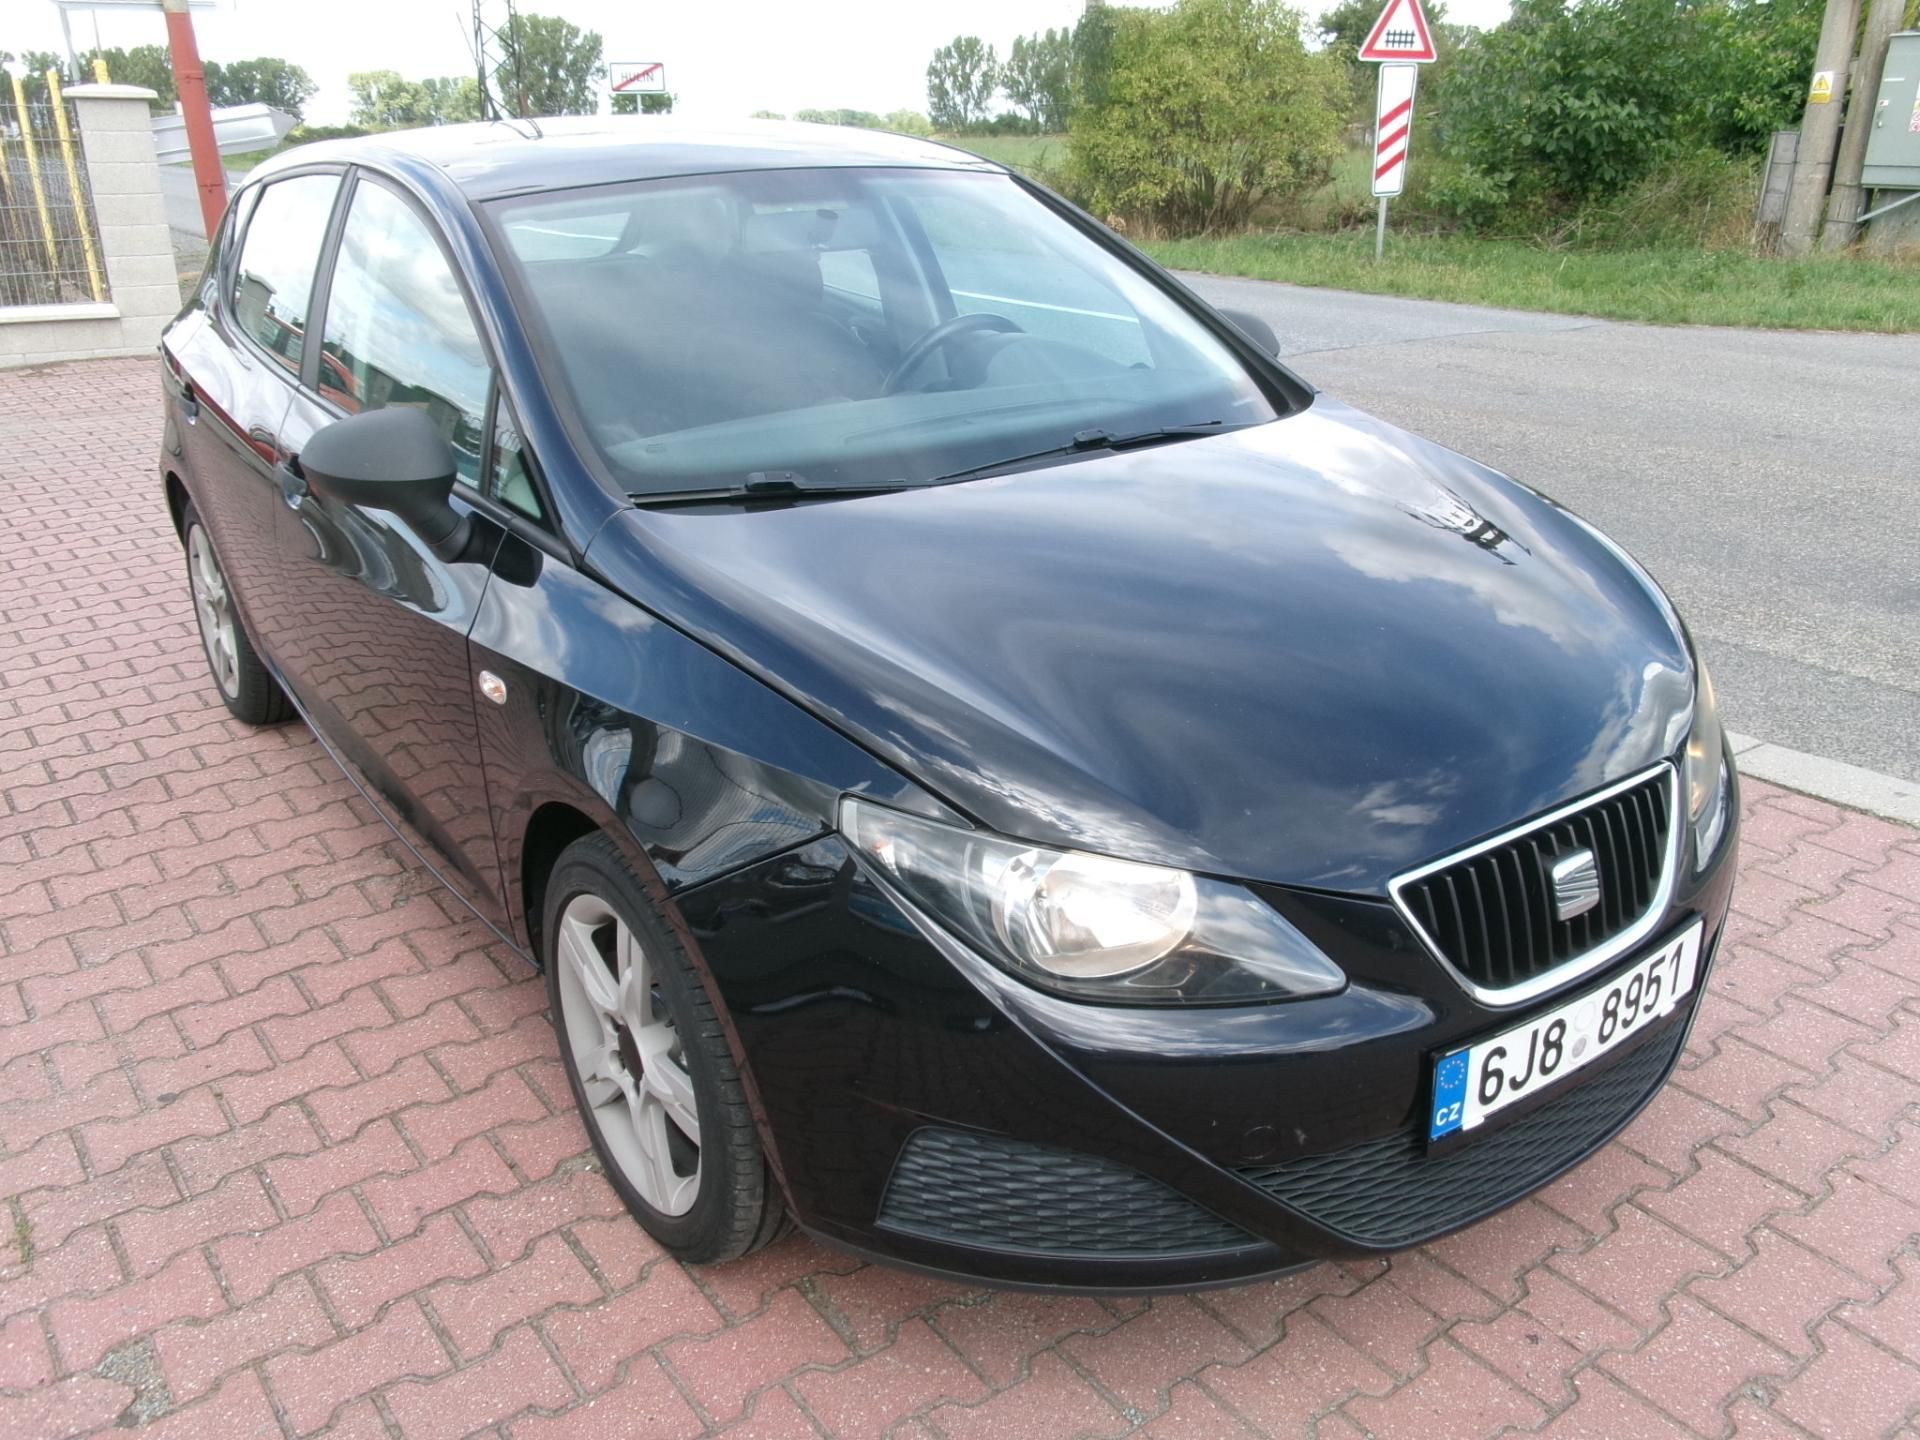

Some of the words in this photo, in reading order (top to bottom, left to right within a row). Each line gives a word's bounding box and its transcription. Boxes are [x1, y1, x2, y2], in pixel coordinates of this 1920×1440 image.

[1478, 1018, 1567, 1106] 6J8
[1598, 940, 1685, 1045] 8951
[1436, 1101, 1461, 1126] CZ
